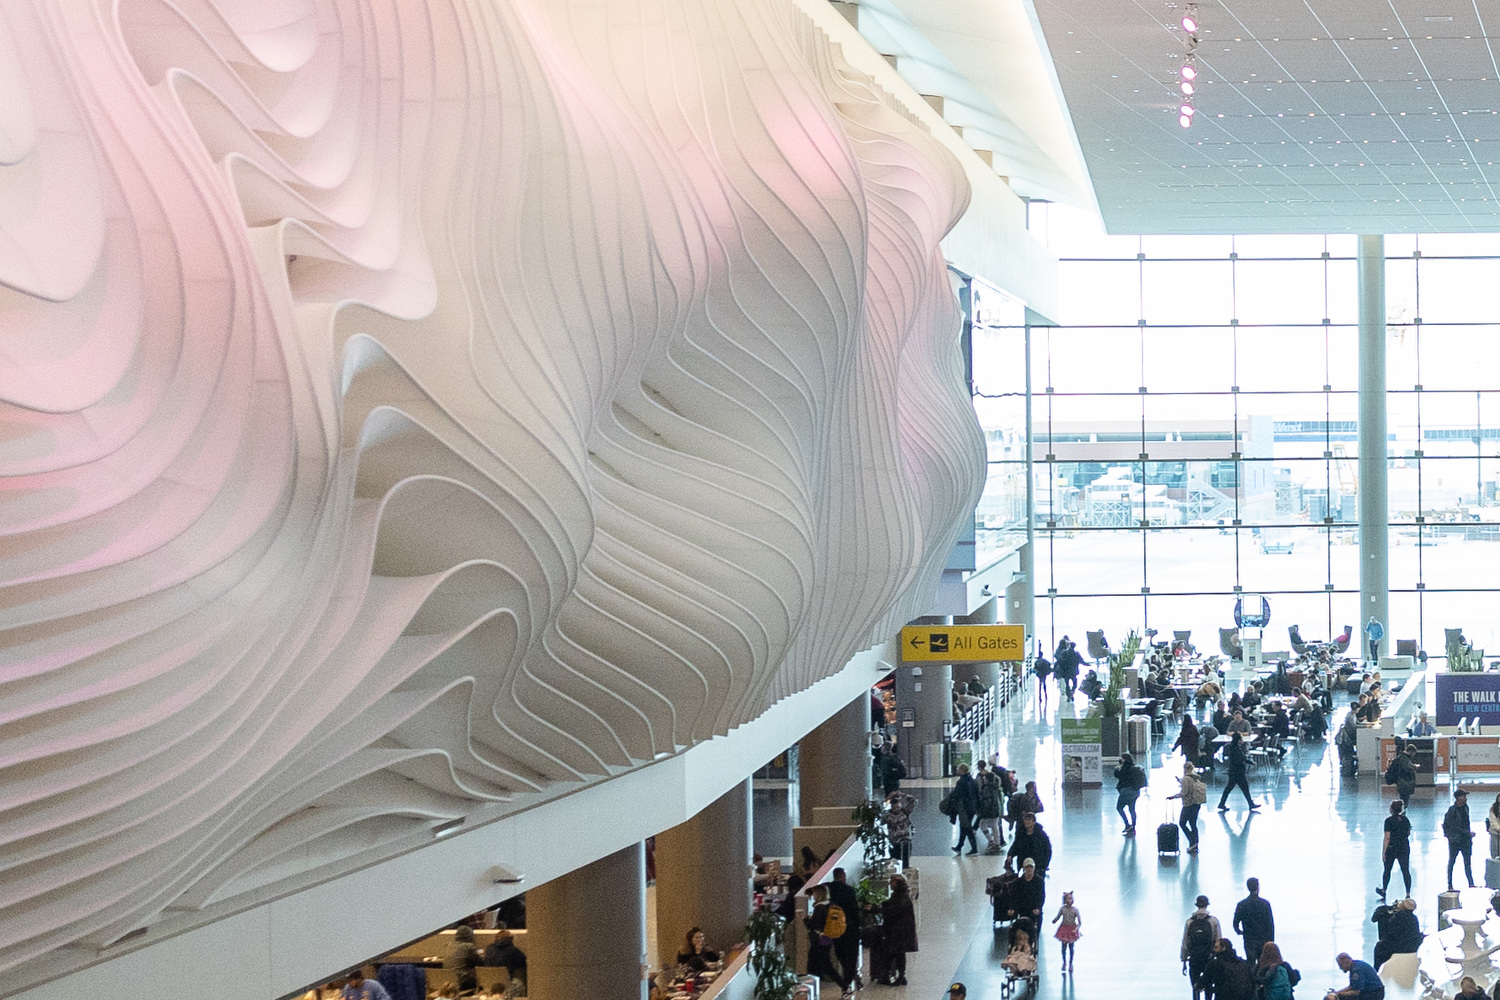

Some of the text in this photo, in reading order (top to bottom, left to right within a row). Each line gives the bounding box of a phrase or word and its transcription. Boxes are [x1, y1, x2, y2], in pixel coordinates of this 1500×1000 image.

[954, 636, 1018, 650] All Gates
[1453, 691, 1469, 703] THE
[1471, 690, 1496, 703] WALK
[1465, 703, 1480, 713] NEW
